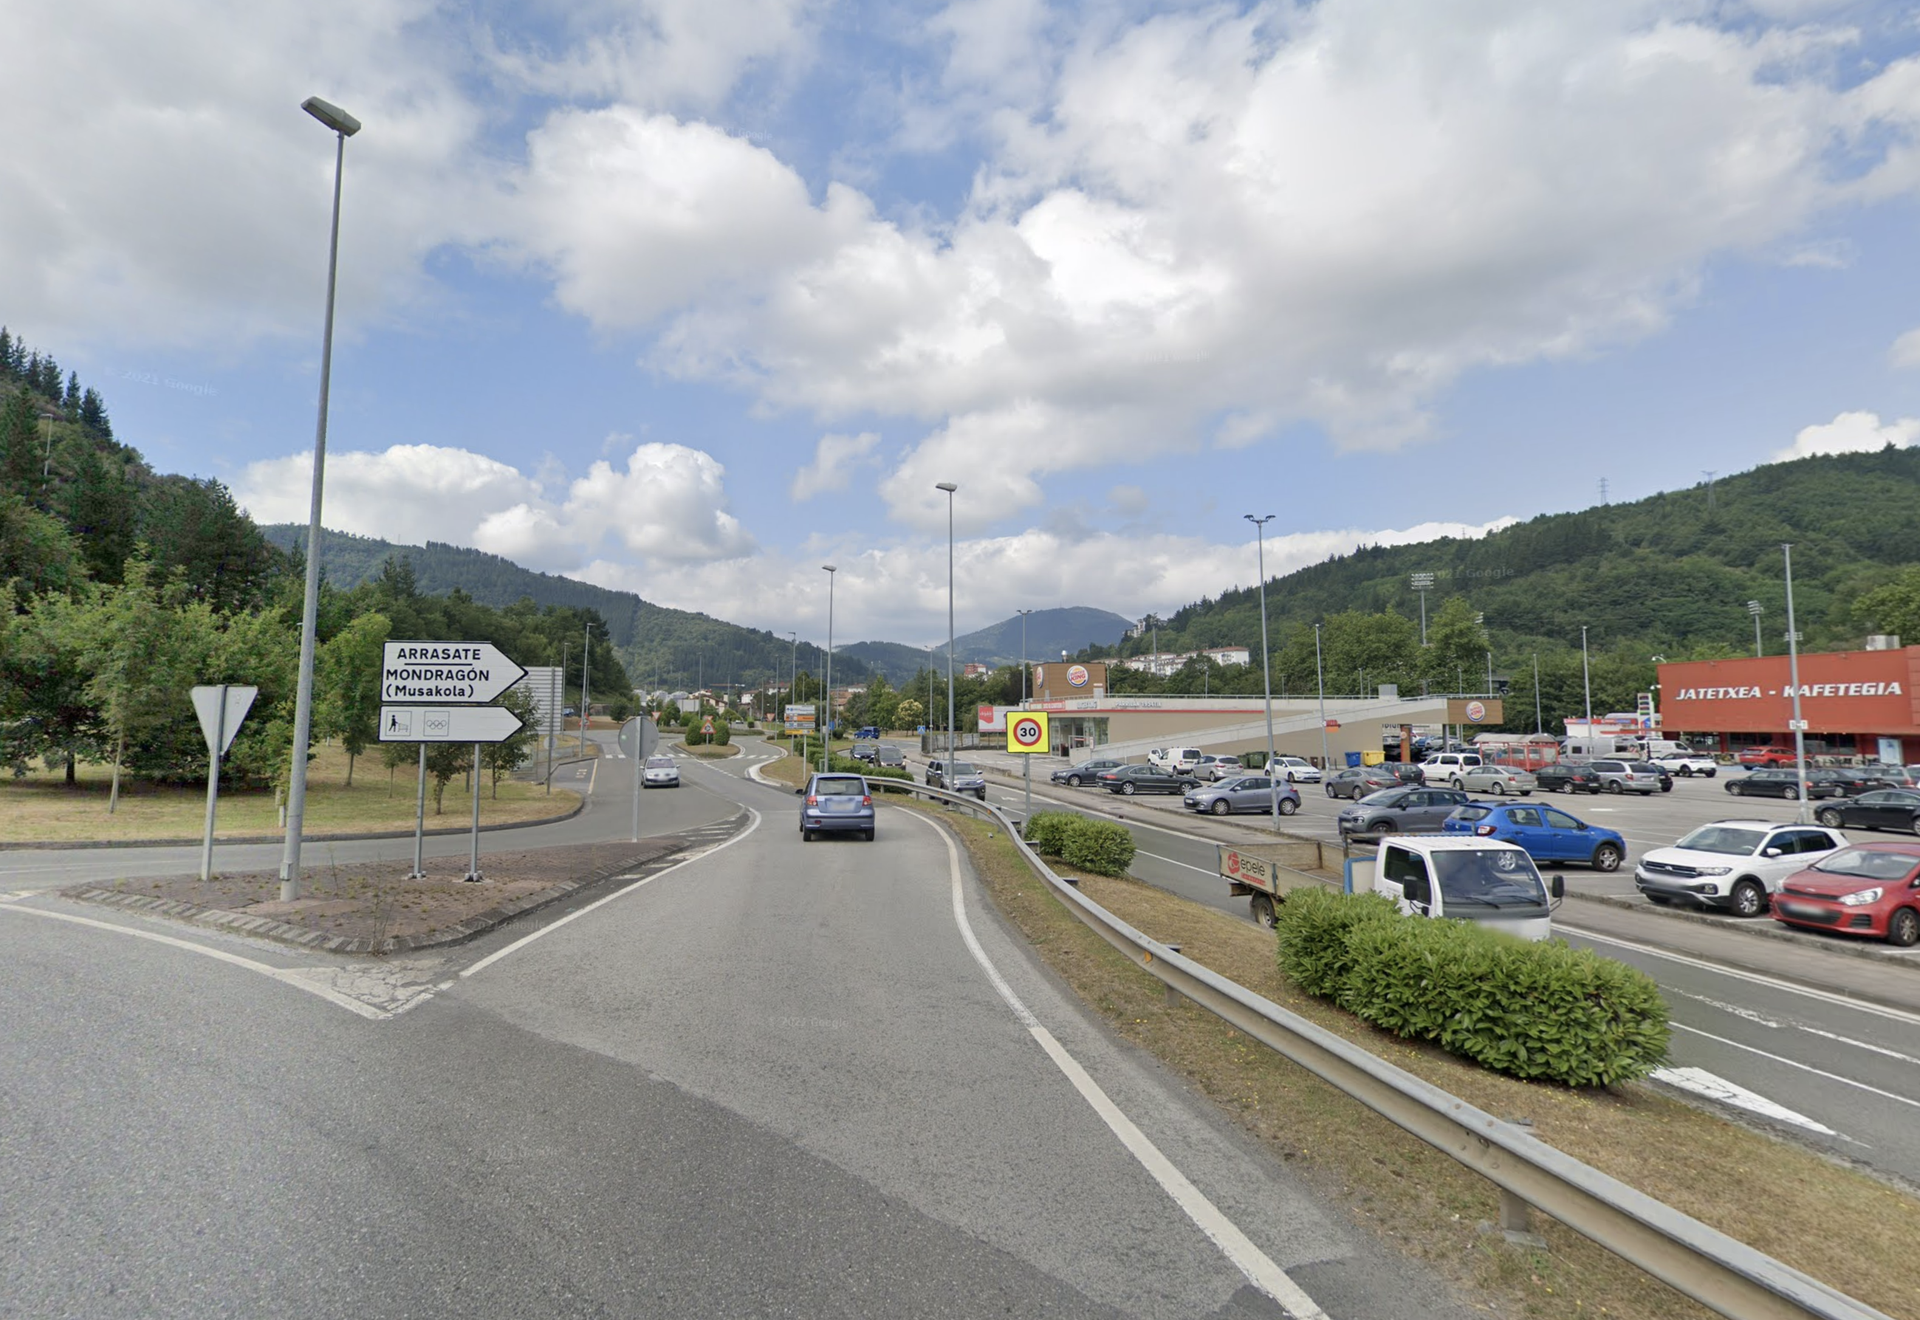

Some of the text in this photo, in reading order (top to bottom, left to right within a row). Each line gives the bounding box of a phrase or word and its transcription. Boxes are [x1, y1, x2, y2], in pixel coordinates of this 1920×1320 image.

[397, 648, 482, 660] ARRASATE
[386, 667, 490, 682] MONDRAGÓN
[386, 684, 475, 698] (Musakola)
[1676, 686, 1762, 701] JATETXEA
[1783, 681, 1903, 698] KAFETEGIA
[1020, 727, 1037, 738] 30
[1240, 859, 1265, 877] epele
